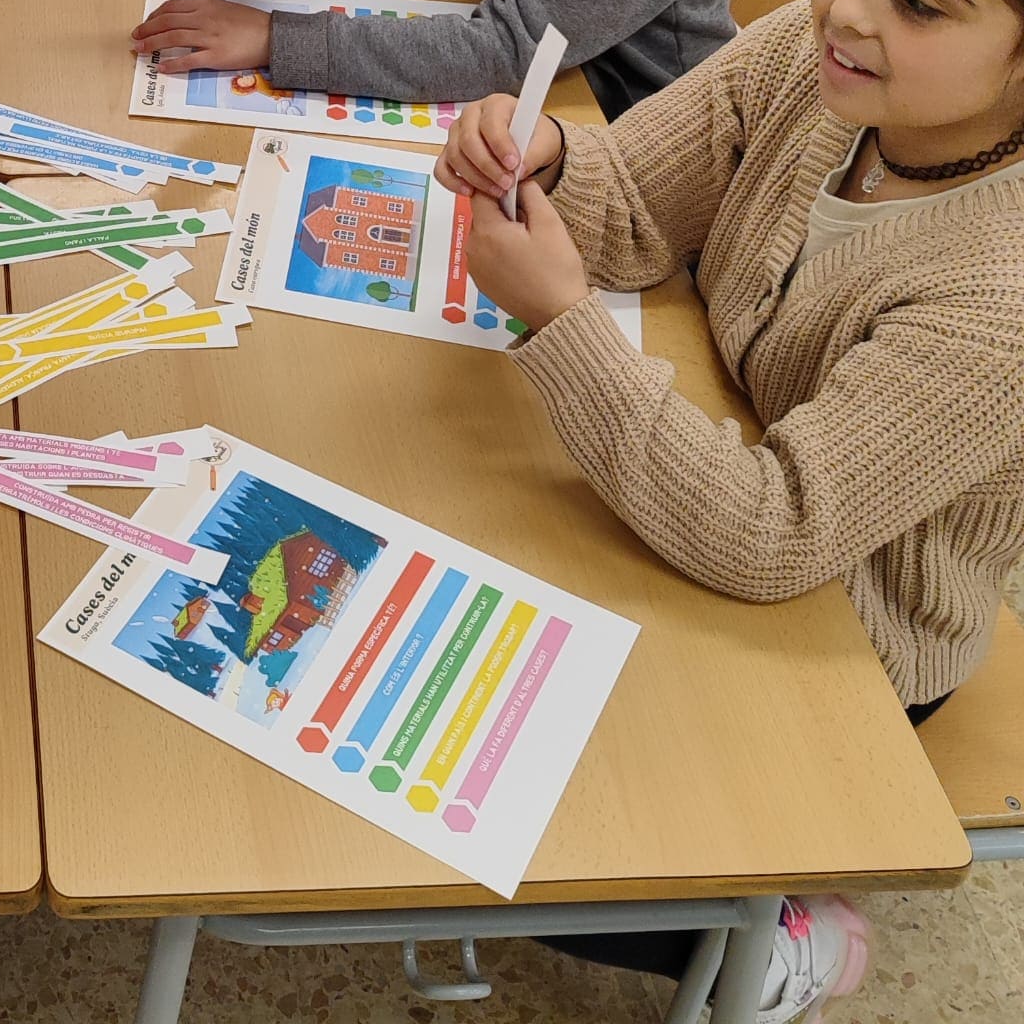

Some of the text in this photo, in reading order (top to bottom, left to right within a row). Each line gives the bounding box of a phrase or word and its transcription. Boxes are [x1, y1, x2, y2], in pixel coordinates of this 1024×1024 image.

[142, 77, 158, 107] Cases
[228, 210, 262, 291] Cases del món
[14, 441, 65, 455] HABITACIONS
[70, 449, 106, 460] PLANTES
[53, 505, 70, 518] LES
[68, 510, 115, 535] CONDICIONS
[59, 498, 77, 512] AMB
[76, 505, 102, 521] PEDRA
[101, 514, 118, 527] PER
[61, 563, 127, 637] Cases del
[336, 669, 357, 693] QUINA
[348, 647, 371, 673] FORMA
[361, 613, 392, 651] ESPECÍFICA
[527, 646, 551, 676] CASES?
[380, 679, 398, 697] COM
[390, 594, 491, 759] QUINS MATERIALS HAN UTILITZAT PER CONTRUIR-LA?
[494, 703, 521, 739] DIFERENT
[484, 744, 500, 759] LA
[489, 734, 505, 749] FA
